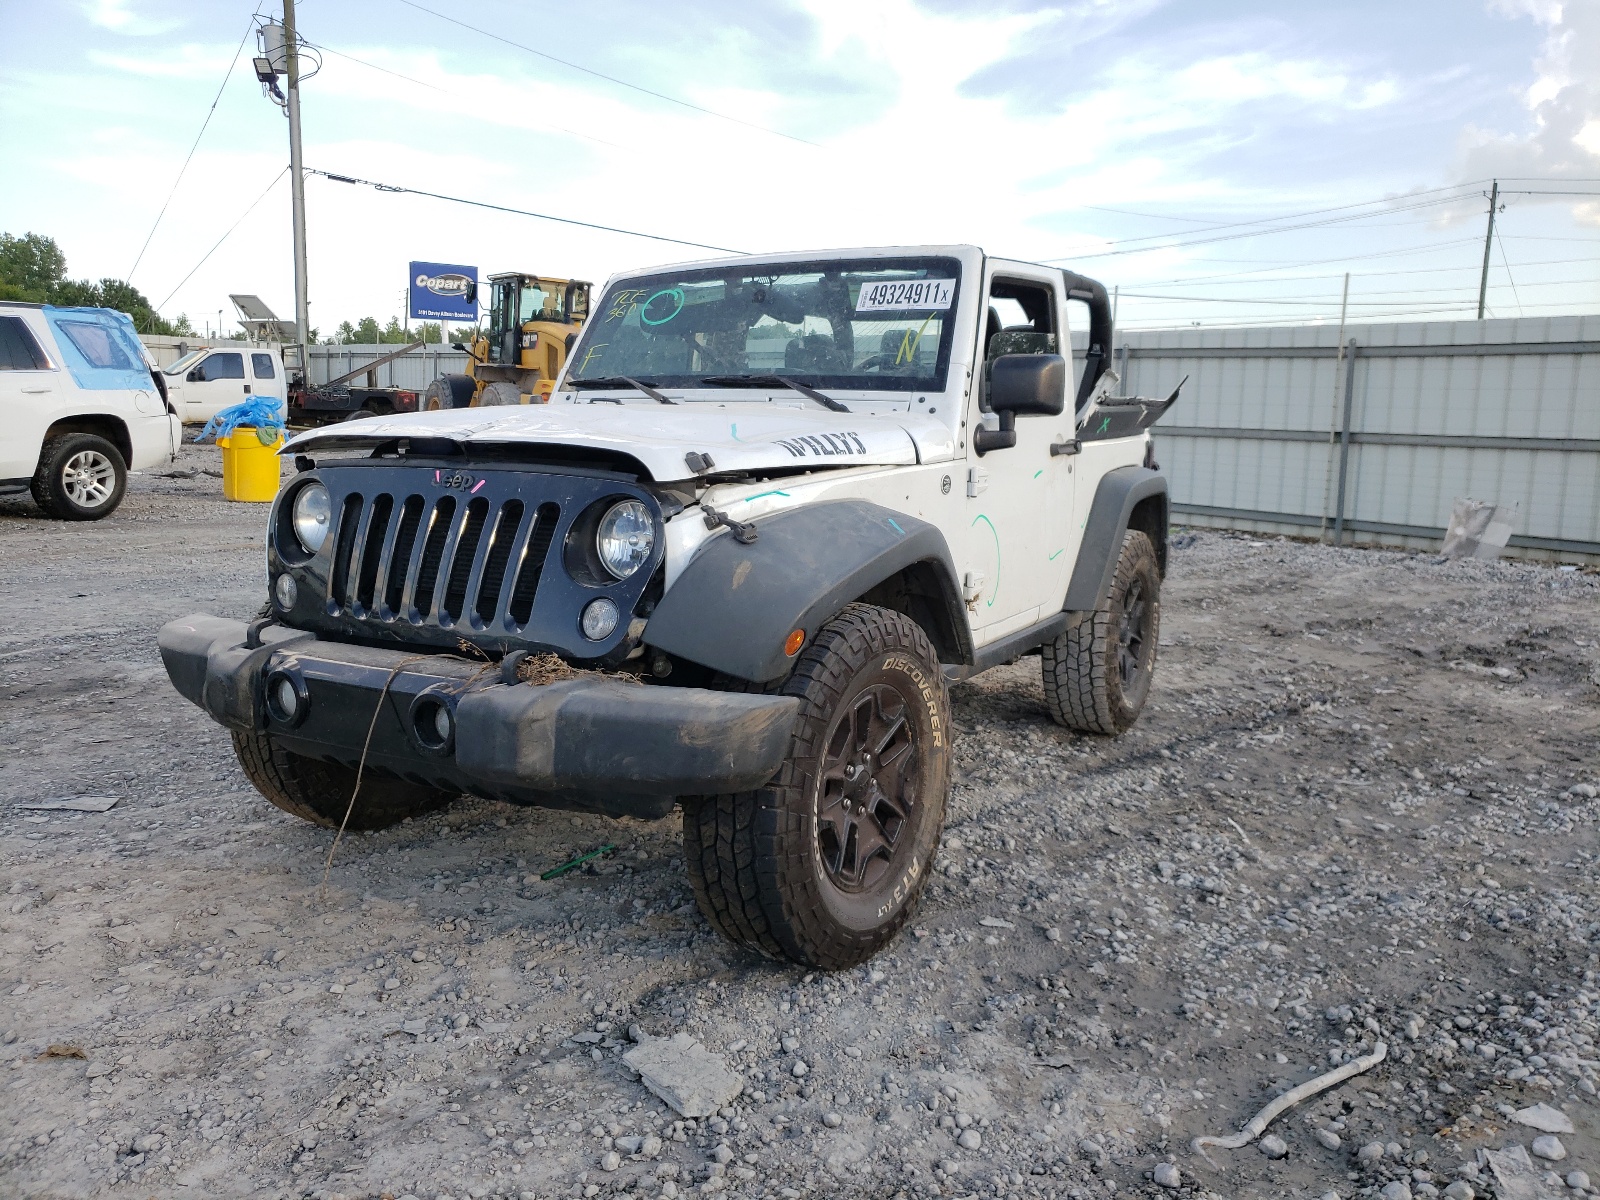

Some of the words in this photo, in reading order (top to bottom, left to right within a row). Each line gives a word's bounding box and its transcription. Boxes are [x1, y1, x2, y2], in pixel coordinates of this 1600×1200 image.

[416, 274, 468, 290] Copart
[869, 283, 940, 305] 49324911
[579, 343, 609, 374] F
[769, 431, 867, 457] WILLYS
[882, 657, 942, 748] DISCOVERER
